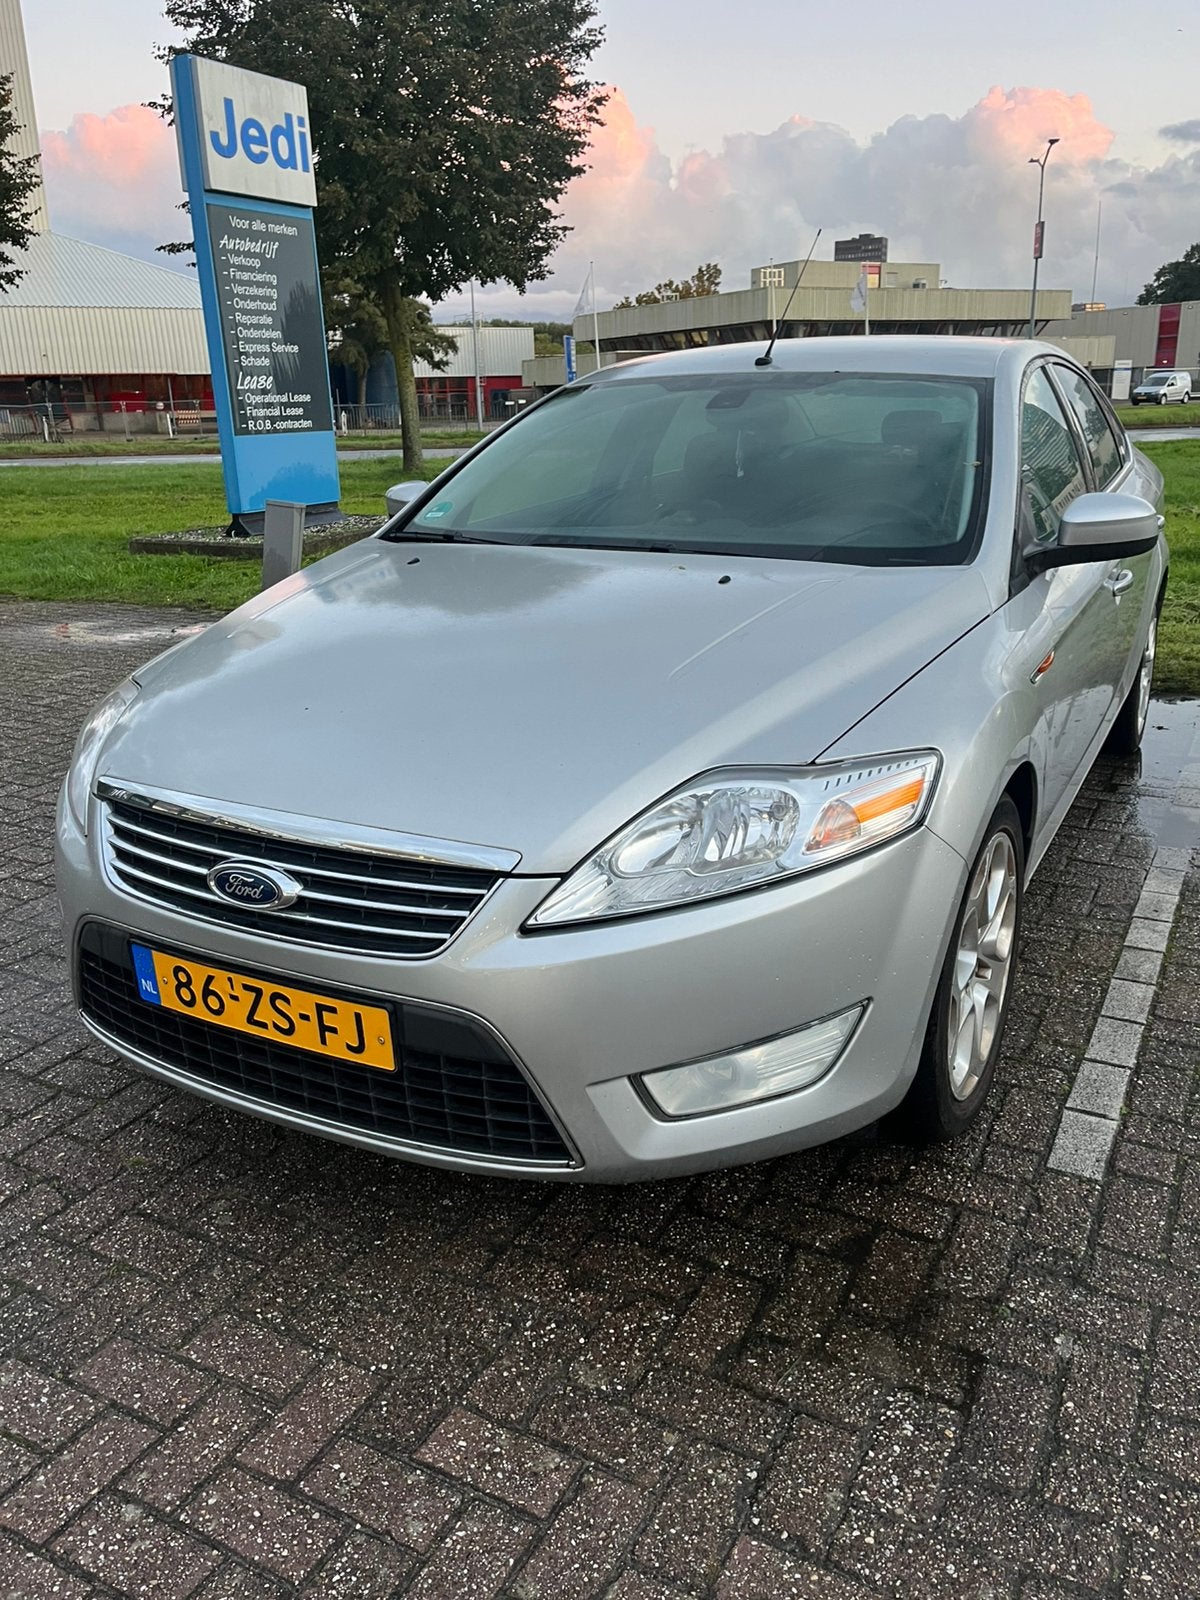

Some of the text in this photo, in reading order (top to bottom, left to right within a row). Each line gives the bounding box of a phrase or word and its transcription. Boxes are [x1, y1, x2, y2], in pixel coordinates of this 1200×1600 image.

[210, 97, 310, 173] Jedi
[229, 215, 298, 236] Voor alle merken
[219, 235, 279, 259] Autobedrijf
[227, 253, 261, 269] Verkoop
[229, 268, 277, 285] Financiering
[231, 283, 278, 299] Verzekering
[233, 297, 277, 311] Onderhoud
[235, 312, 273, 325] Reparatie
[237, 327, 282, 338] Onderdelen
[238, 341, 299, 353] Express Service
[240, 355, 270, 366] Schade
[236, 371, 273, 389] Lease
[244, 392, 312, 405] Operational Lease
[246, 406, 304, 417] Financial Lease
[248, 419, 313, 430] R.O.B.-contracten
[224, 873, 263, 900] Ford
[141, 977, 158, 994] NL
[172, 964, 366, 1056] 86-ZS-FJ
